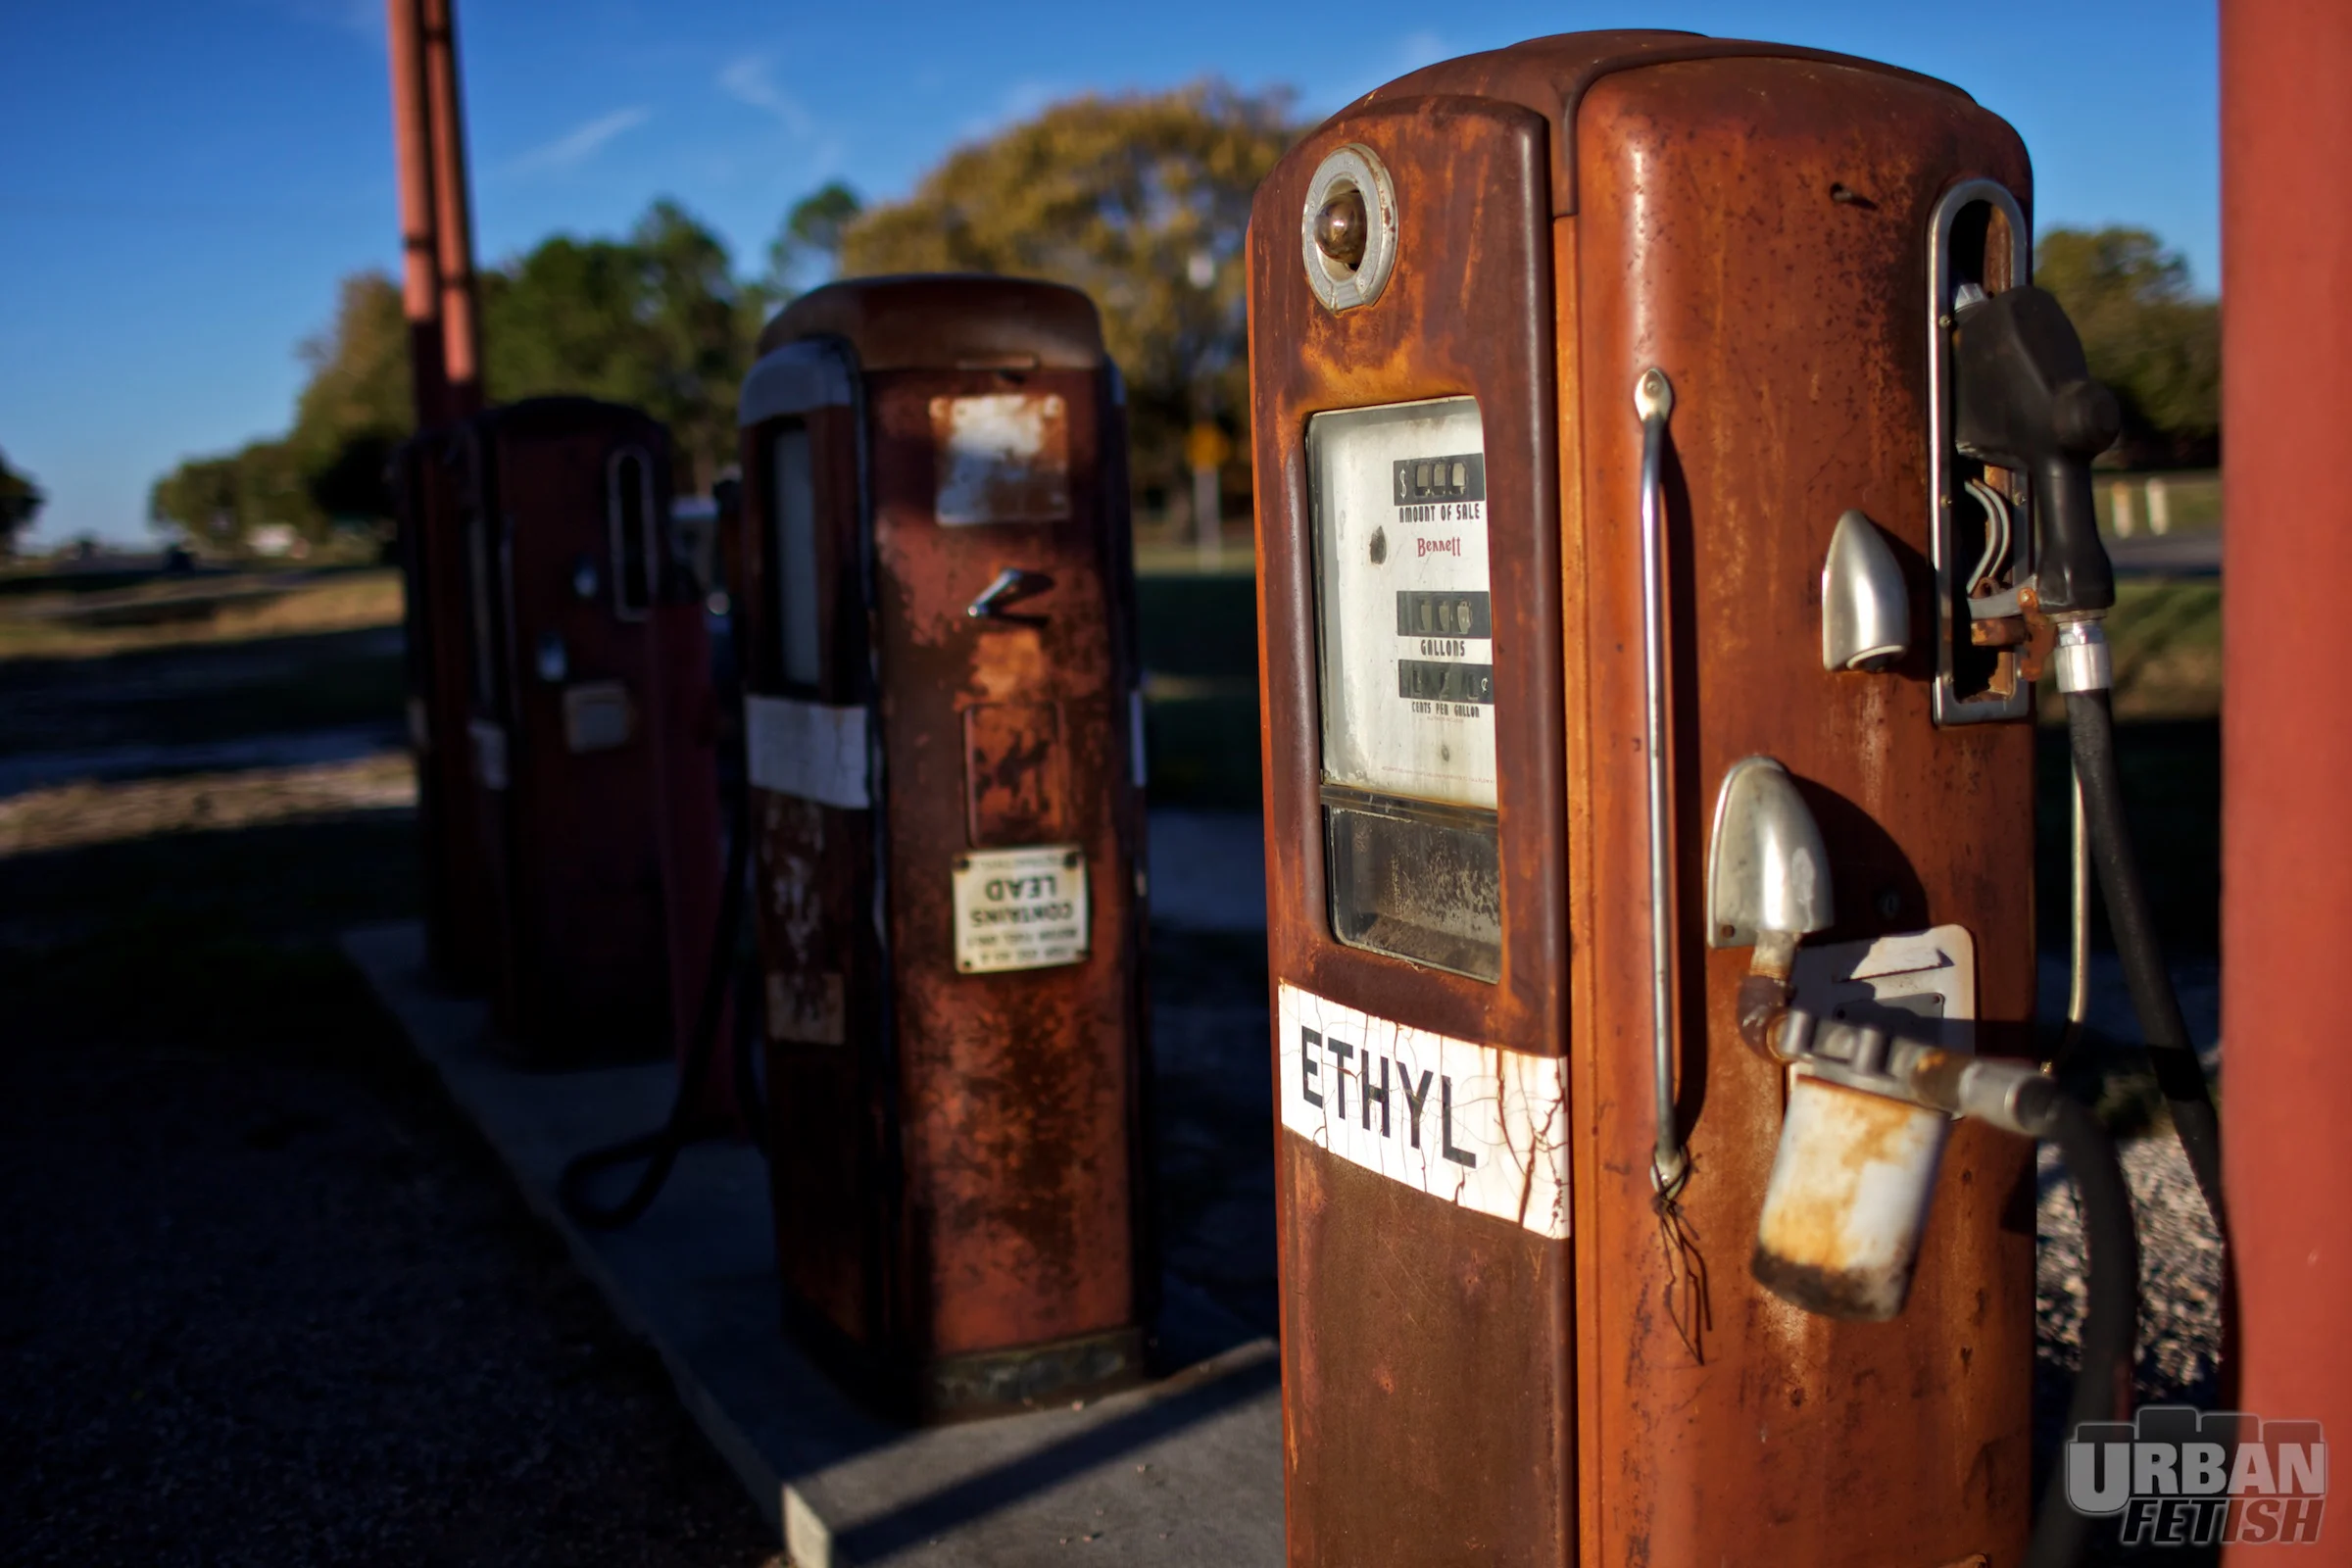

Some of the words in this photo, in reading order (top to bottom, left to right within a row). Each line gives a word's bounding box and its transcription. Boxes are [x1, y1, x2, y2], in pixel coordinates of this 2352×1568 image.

[1399, 506, 1435, 523] AMOUNT
[1441, 504, 1451, 521] OF
[1456, 503, 1480, 520] SALE
[1417, 536, 1461, 558] Bennett
[1420, 639, 1465, 657] GALLONS
[1411, 701, 1431, 714] CENTS
[1436, 703, 1448, 716] PER
[1454, 704, 1480, 718] GALLON
[985, 875, 1056, 901] LEAD
[970, 902, 1073, 927] CONTAINS
[1301, 1025, 1476, 1169] ETHYL
